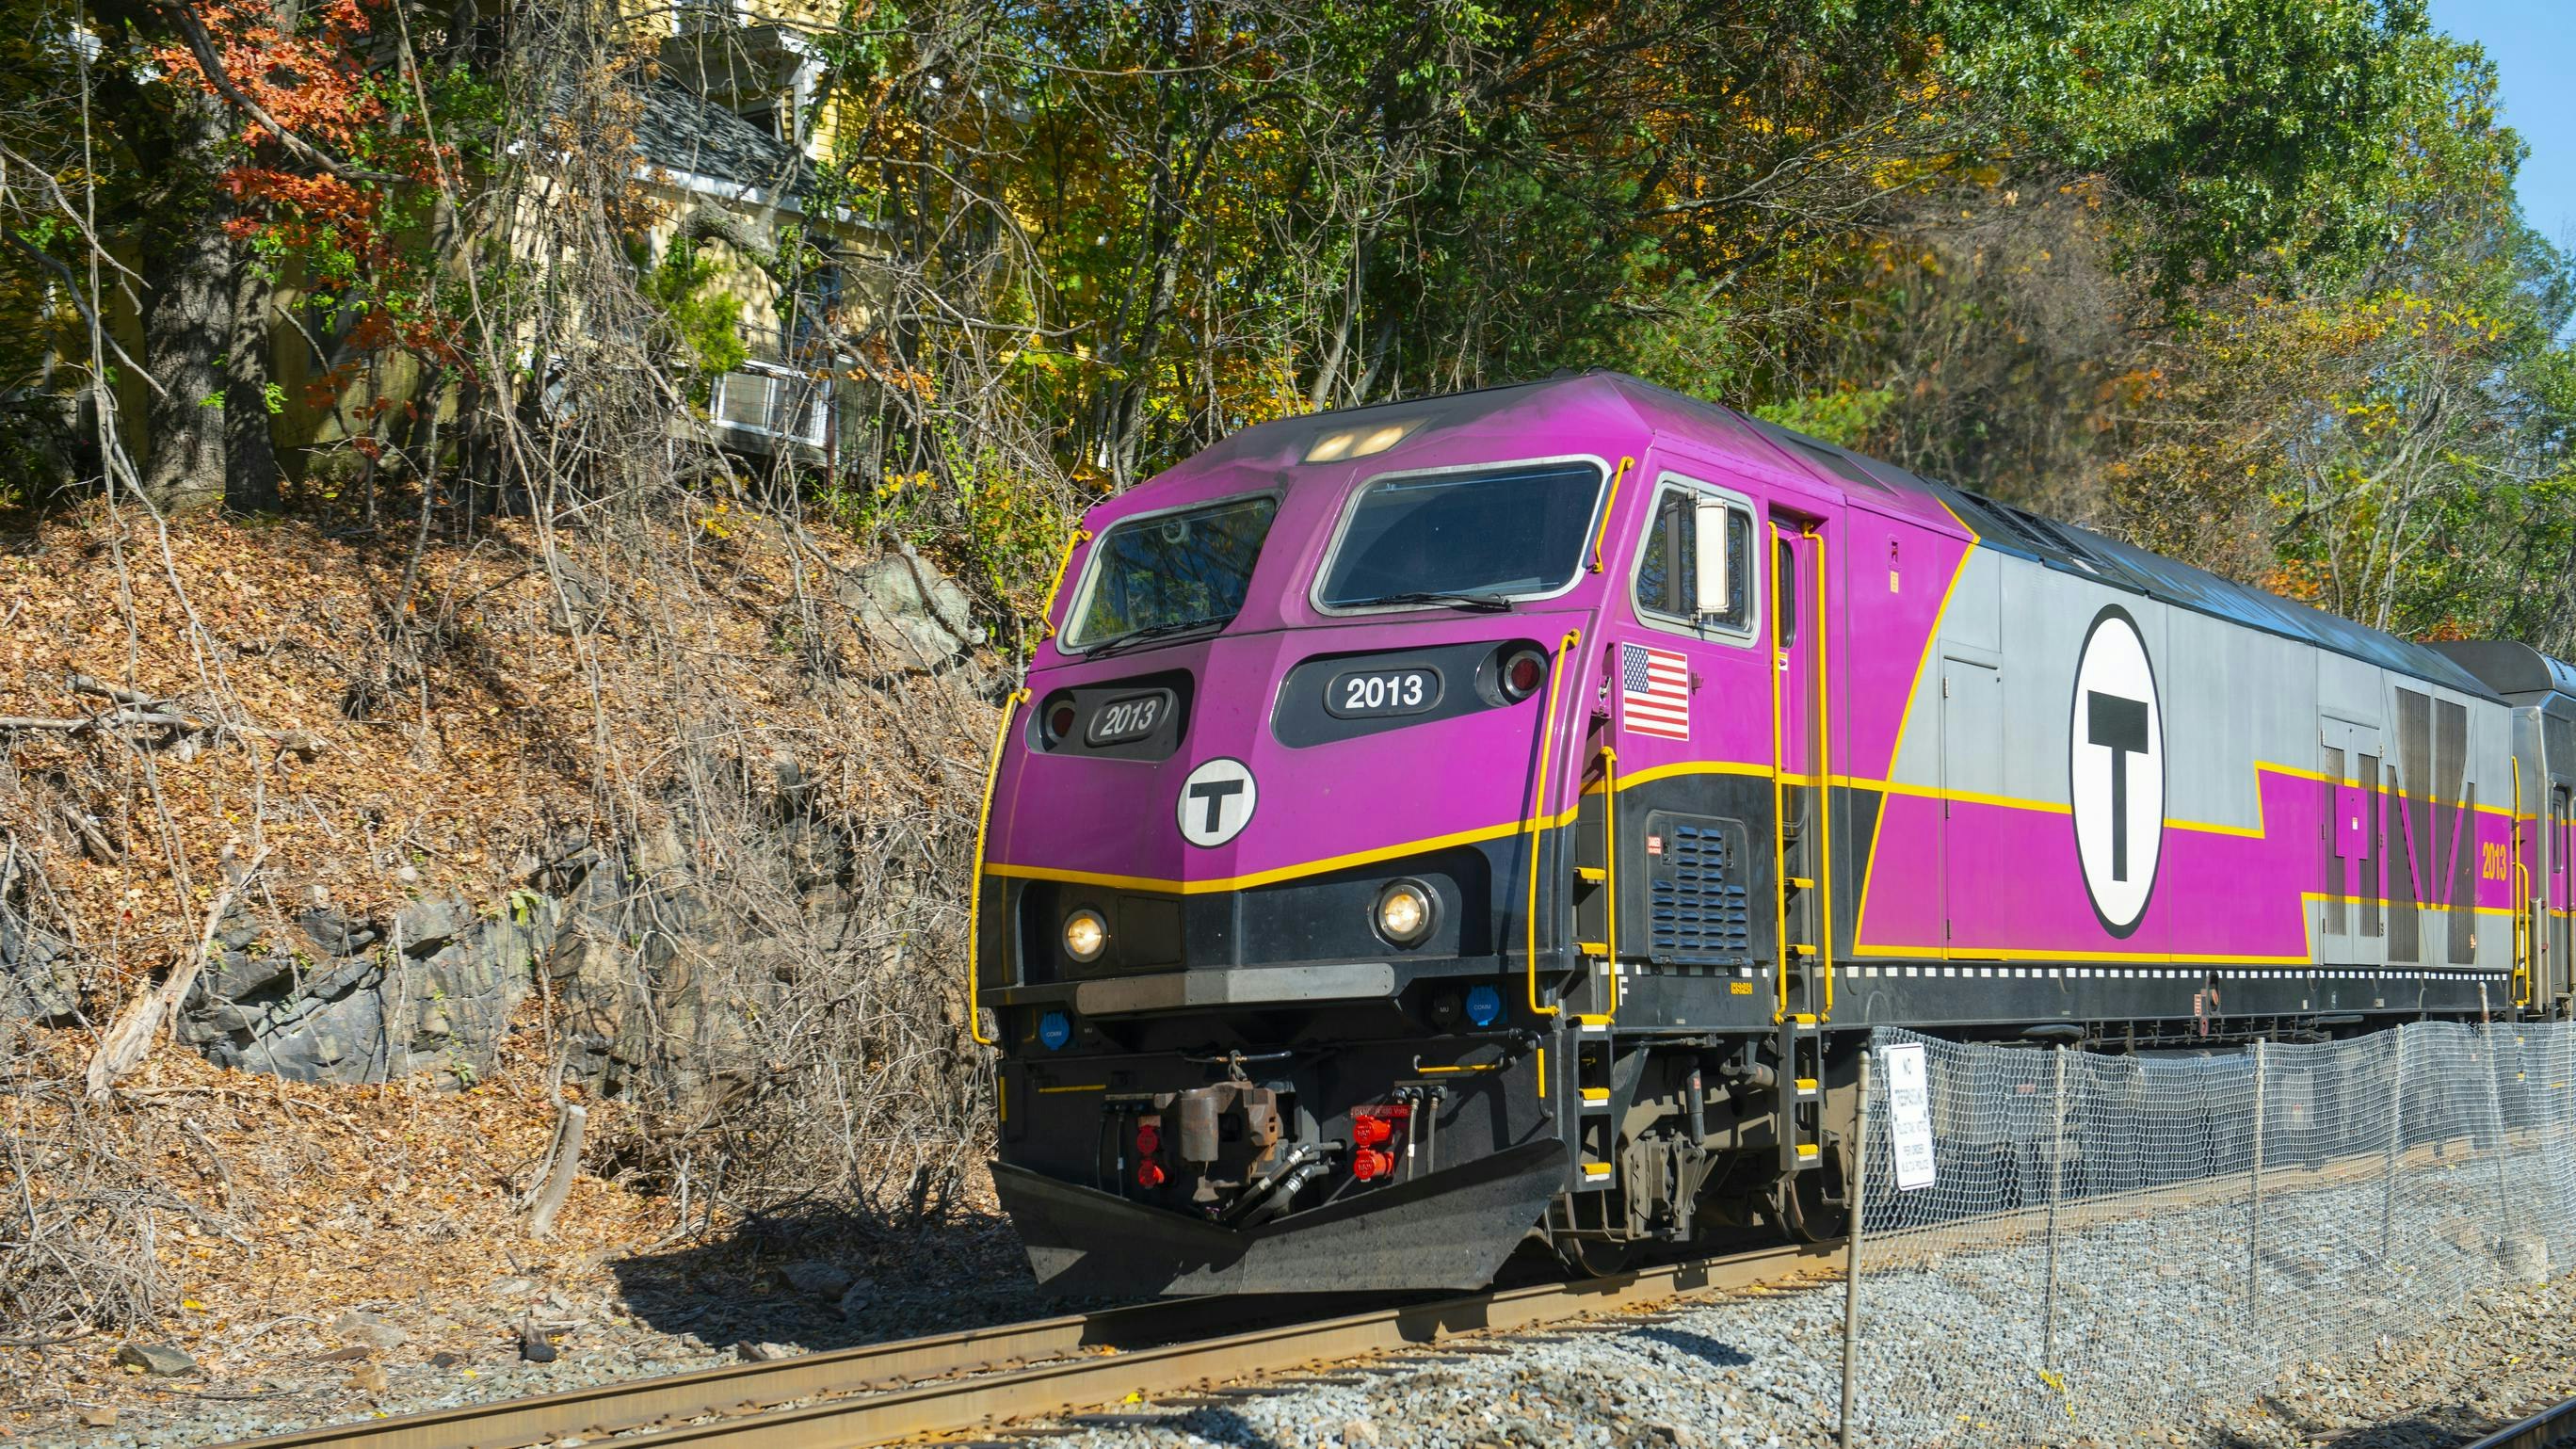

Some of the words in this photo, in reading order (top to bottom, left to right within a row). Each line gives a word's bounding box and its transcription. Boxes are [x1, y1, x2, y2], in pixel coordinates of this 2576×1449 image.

[1344, 674, 1423, 709] 2013
[1099, 700, 1157, 736] 2013
[2087, 689, 2149, 882] T
[1189, 779, 1245, 833] T
[2482, 841, 2507, 881] 2013
[1618, 975, 1629, 1006] F
